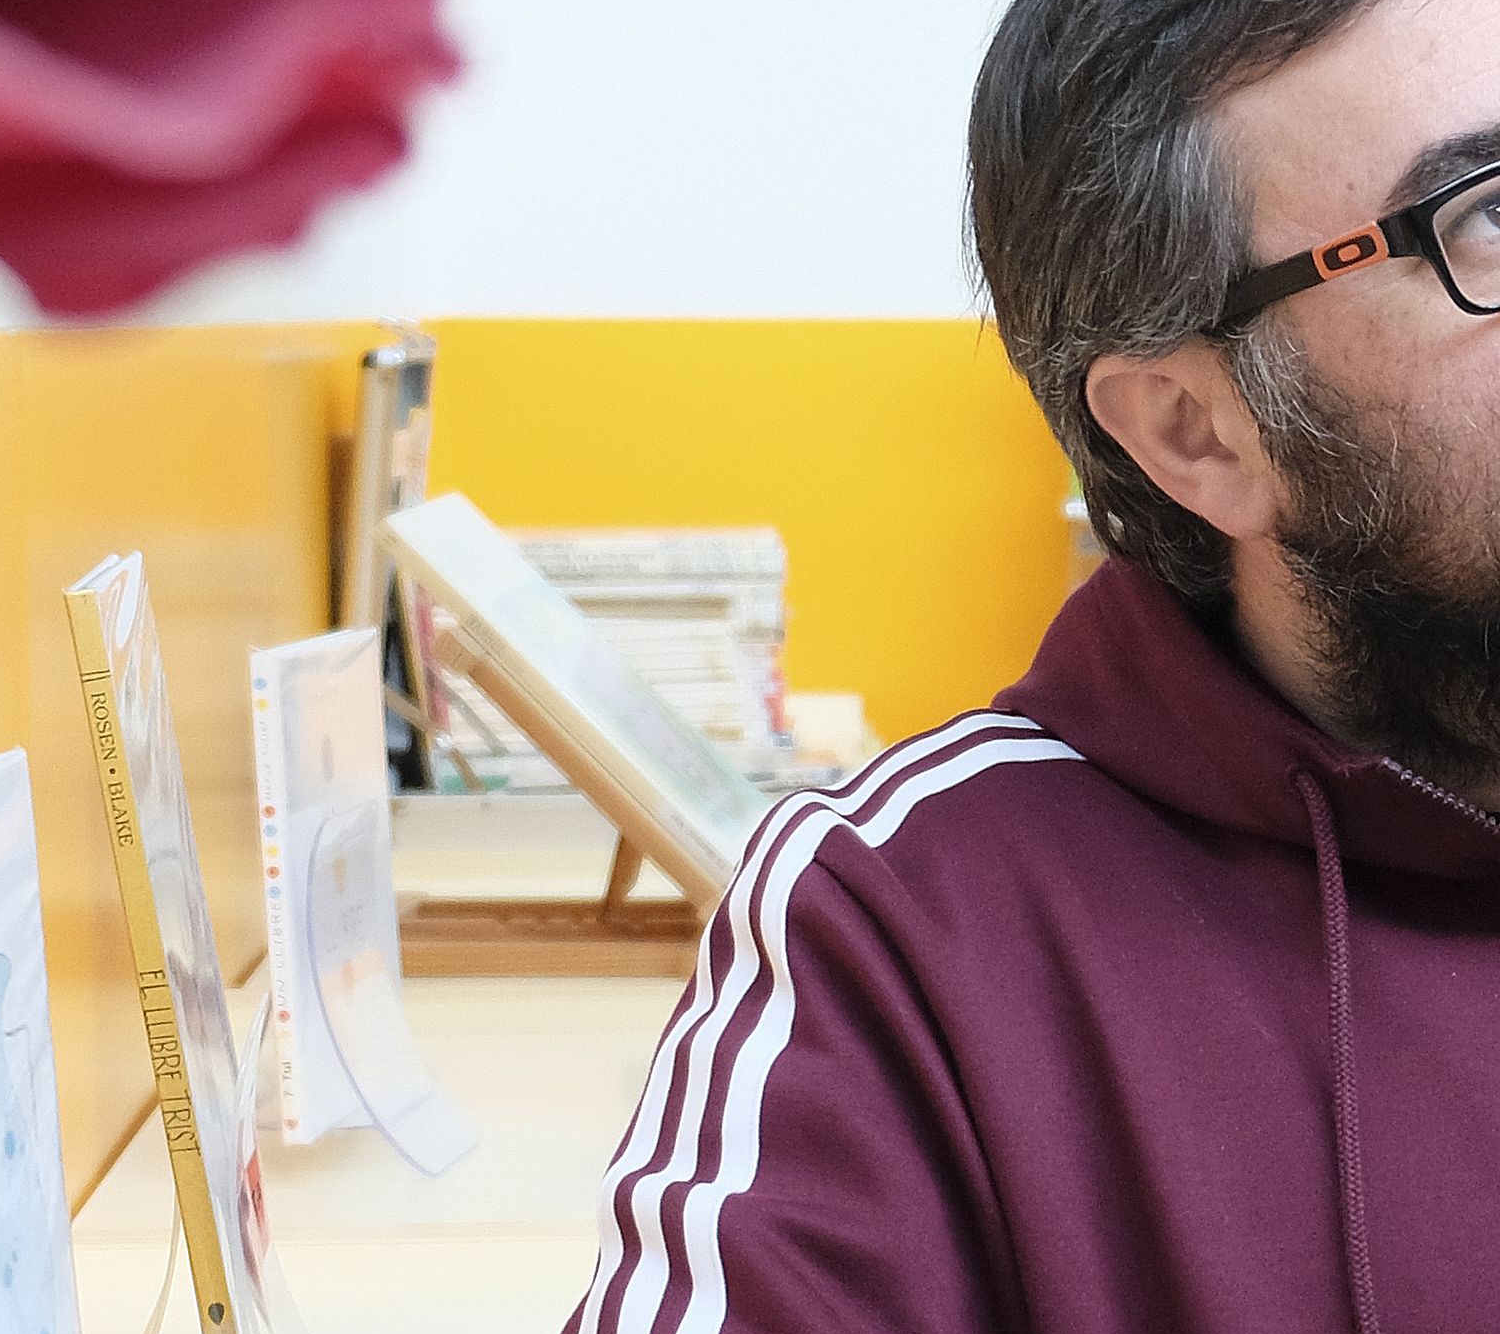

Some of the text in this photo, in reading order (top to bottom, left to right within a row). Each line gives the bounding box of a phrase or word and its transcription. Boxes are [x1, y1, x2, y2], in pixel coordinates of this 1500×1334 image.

[90, 691, 134, 847] ROSEN BLAKE
[139, 969, 201, 1157] EL LLIBRE TRIST
